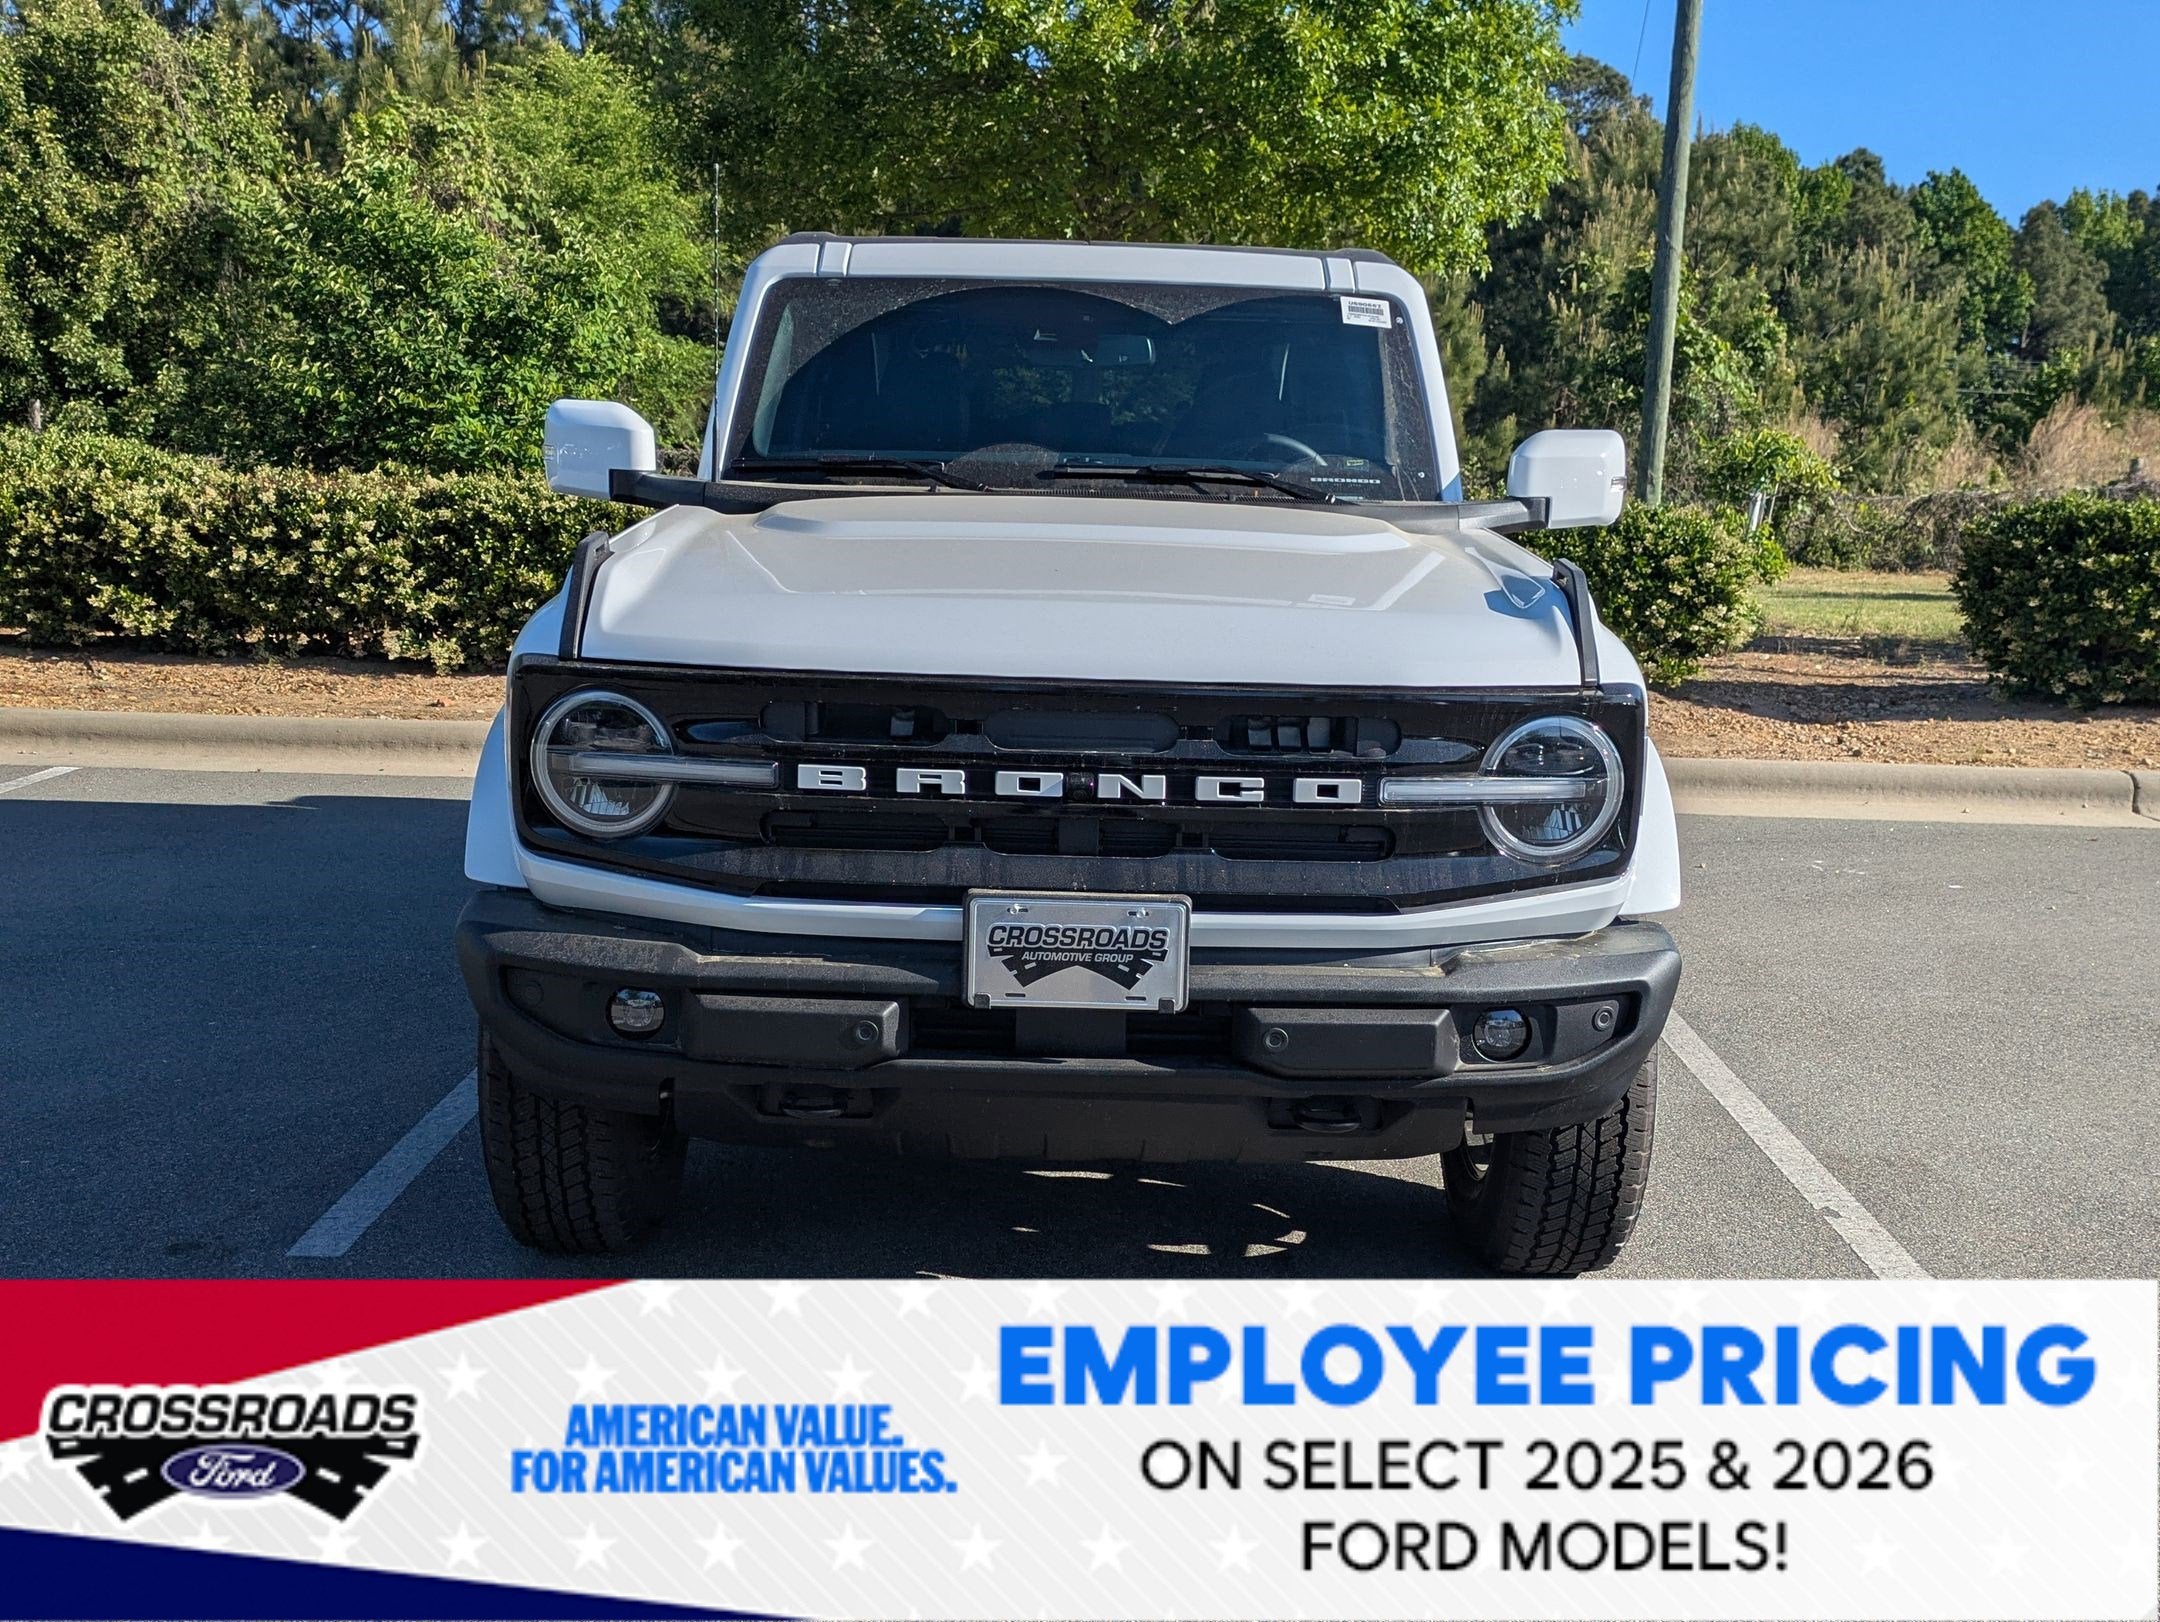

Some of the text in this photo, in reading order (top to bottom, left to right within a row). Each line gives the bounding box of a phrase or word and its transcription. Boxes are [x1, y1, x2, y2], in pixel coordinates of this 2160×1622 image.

[797, 763, 1363, 805] BRONCO
[988, 925, 1169, 949] CROSSROADS
[1021, 951, 1134, 963] AUTOMOTIVE GROUP
